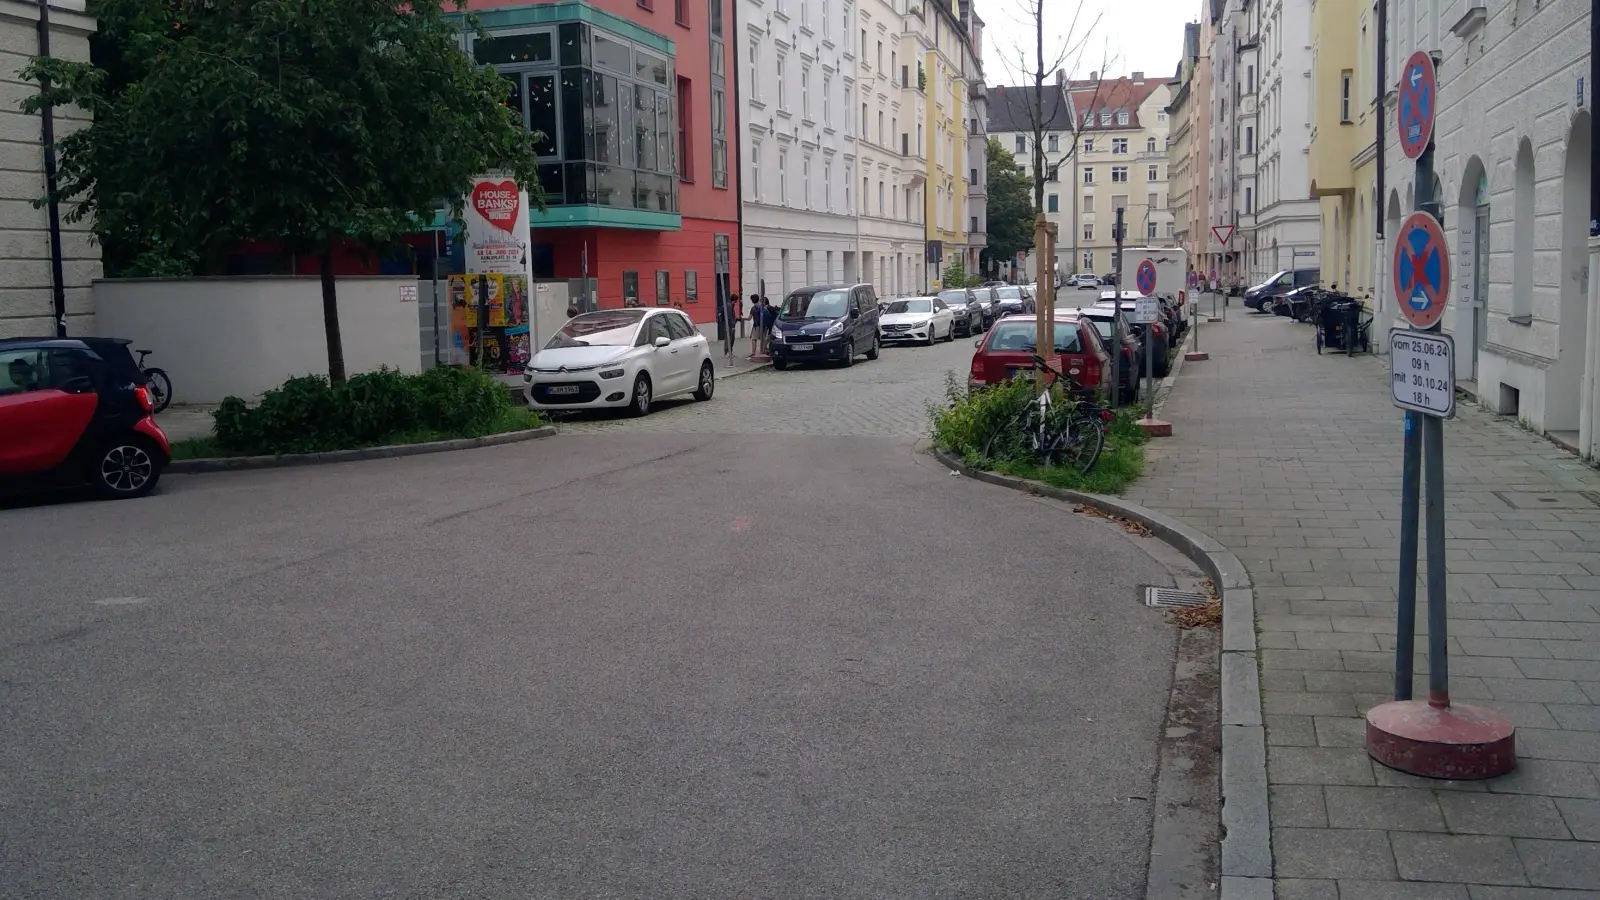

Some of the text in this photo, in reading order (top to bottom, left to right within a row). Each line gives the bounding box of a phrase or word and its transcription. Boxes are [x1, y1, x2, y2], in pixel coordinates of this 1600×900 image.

[480, 190, 511, 199] HOUSE
[1461, 229, 1472, 303] GALERIE
[1393, 340, 1448, 357] vom 25.06.24
[1411, 357, 1430, 371] 09 h
[1394, 371, 1448, 392] mit 30.10.24
[1412, 391, 1430, 406] 18 h
